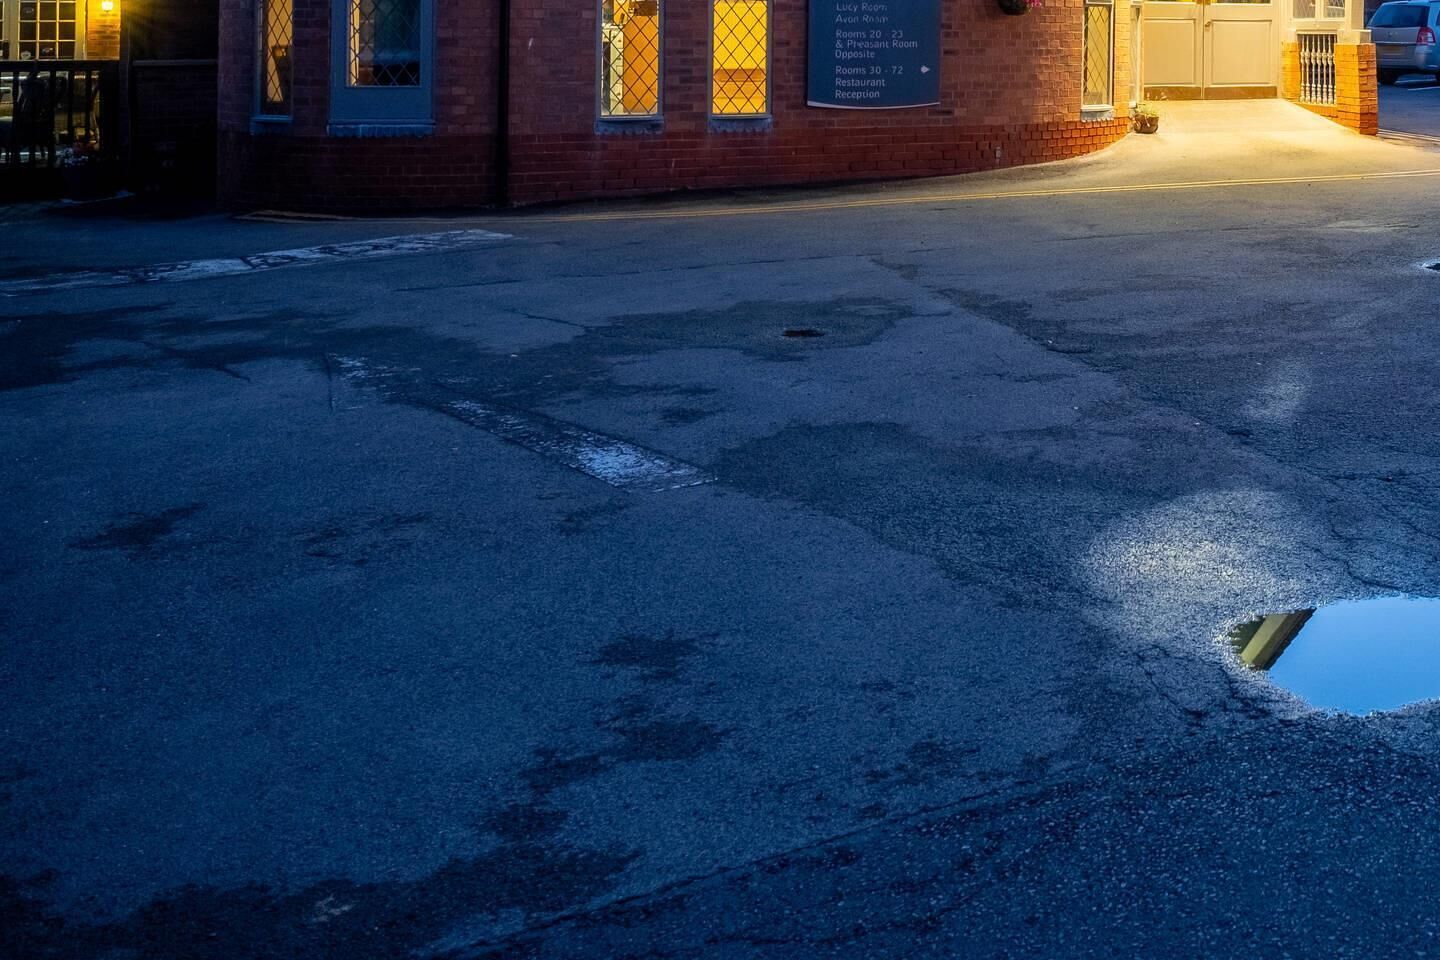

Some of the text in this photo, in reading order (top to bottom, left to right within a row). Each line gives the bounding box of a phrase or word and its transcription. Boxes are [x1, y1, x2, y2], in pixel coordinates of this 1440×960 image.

[836, 3, 888, 12] Lucy Room
[835, 14, 859, 23] Avon
[836, 30, 867, 38] Rooms
[869, 30, 882, 38] 20
[891, 30, 904, 38] 23
[835, 39, 918, 49] & Pheasant Room
[835, 49, 875, 59] Opposite
[835, 66, 867, 74] Rooms
[869, 66, 882, 74] 30
[891, 66, 904, 74] 72
[835, 78, 886, 87] Restaurant
[835, 90, 880, 99] Reception
